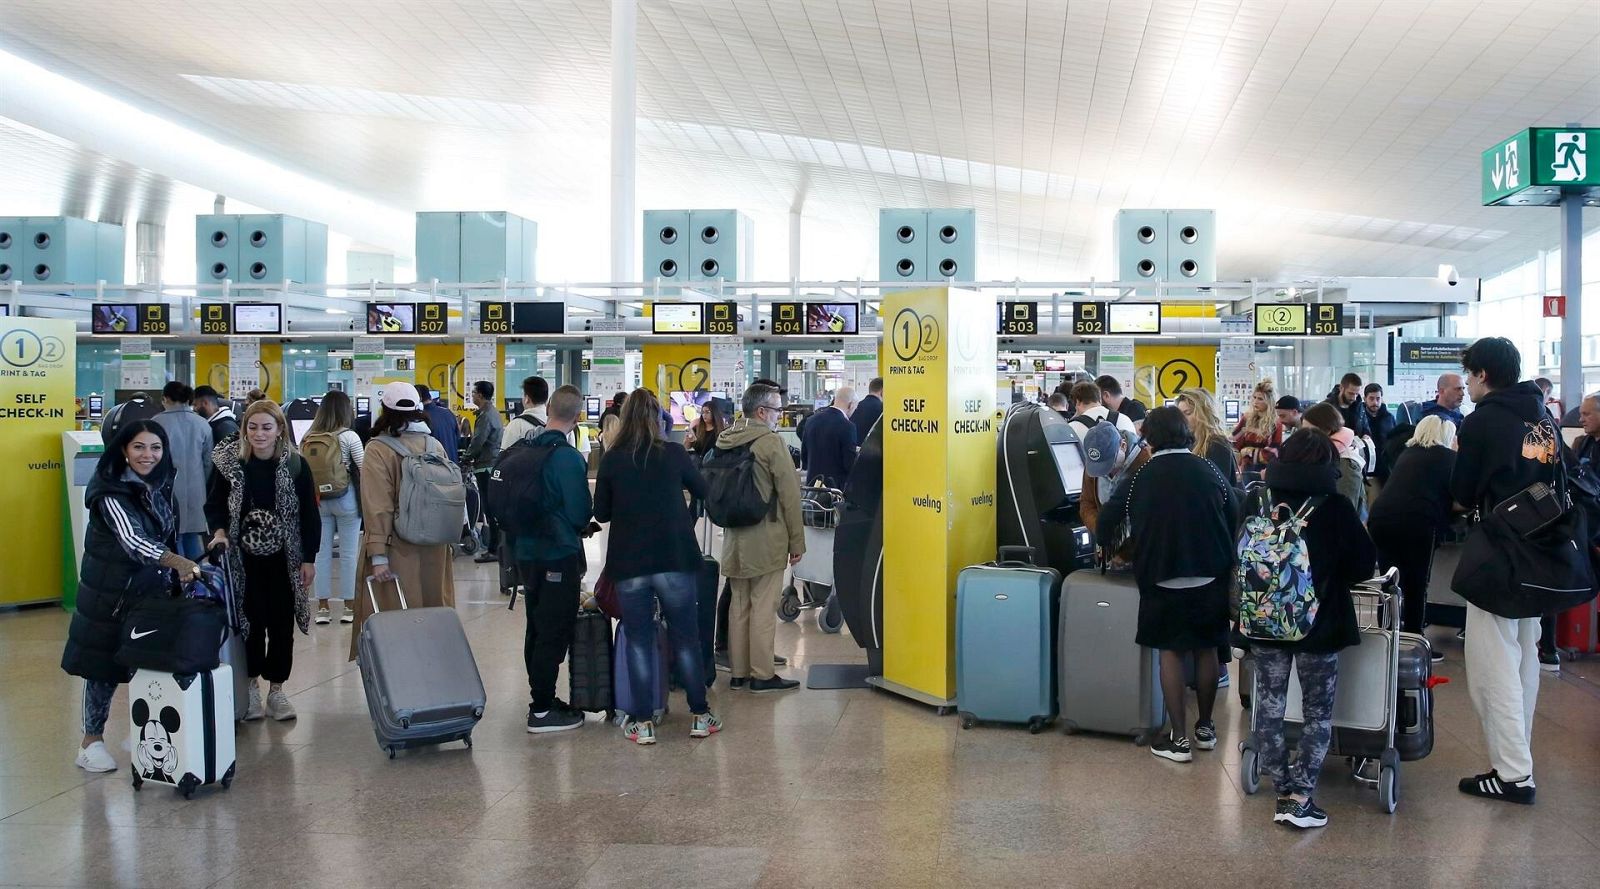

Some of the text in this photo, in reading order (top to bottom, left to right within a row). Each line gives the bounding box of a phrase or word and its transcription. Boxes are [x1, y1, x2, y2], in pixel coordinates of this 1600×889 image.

[1278, 311, 1286, 322] 2
[143, 321, 166, 332] 509
[203, 321, 227, 332] 508
[420, 321, 444, 332] 507
[483, 321, 508, 332] 506
[709, 321, 734, 333] 505
[774, 321, 800, 333] 504
[1008, 321, 1034, 332] 503
[1076, 321, 1102, 332] 502
[1315, 322, 1339, 333] 501
[902, 320, 909, 349] 1
[924, 323, 932, 345] 2
[16, 338, 56, 358] 1 2
[890, 366, 925, 375] PRINT & TAG
[1172, 369, 1188, 394] 2
[16, 393, 47, 404] SELF
[903, 399, 925, 412] SELF
[964, 400, 982, 413] SELF
[891, 418, 939, 433] CHECK-IN
[954, 419, 991, 433] CHECK-IN
[28, 459, 62, 470] vuelin
[912, 494, 942, 513] vueling
[971, 491, 993, 507] vueling
